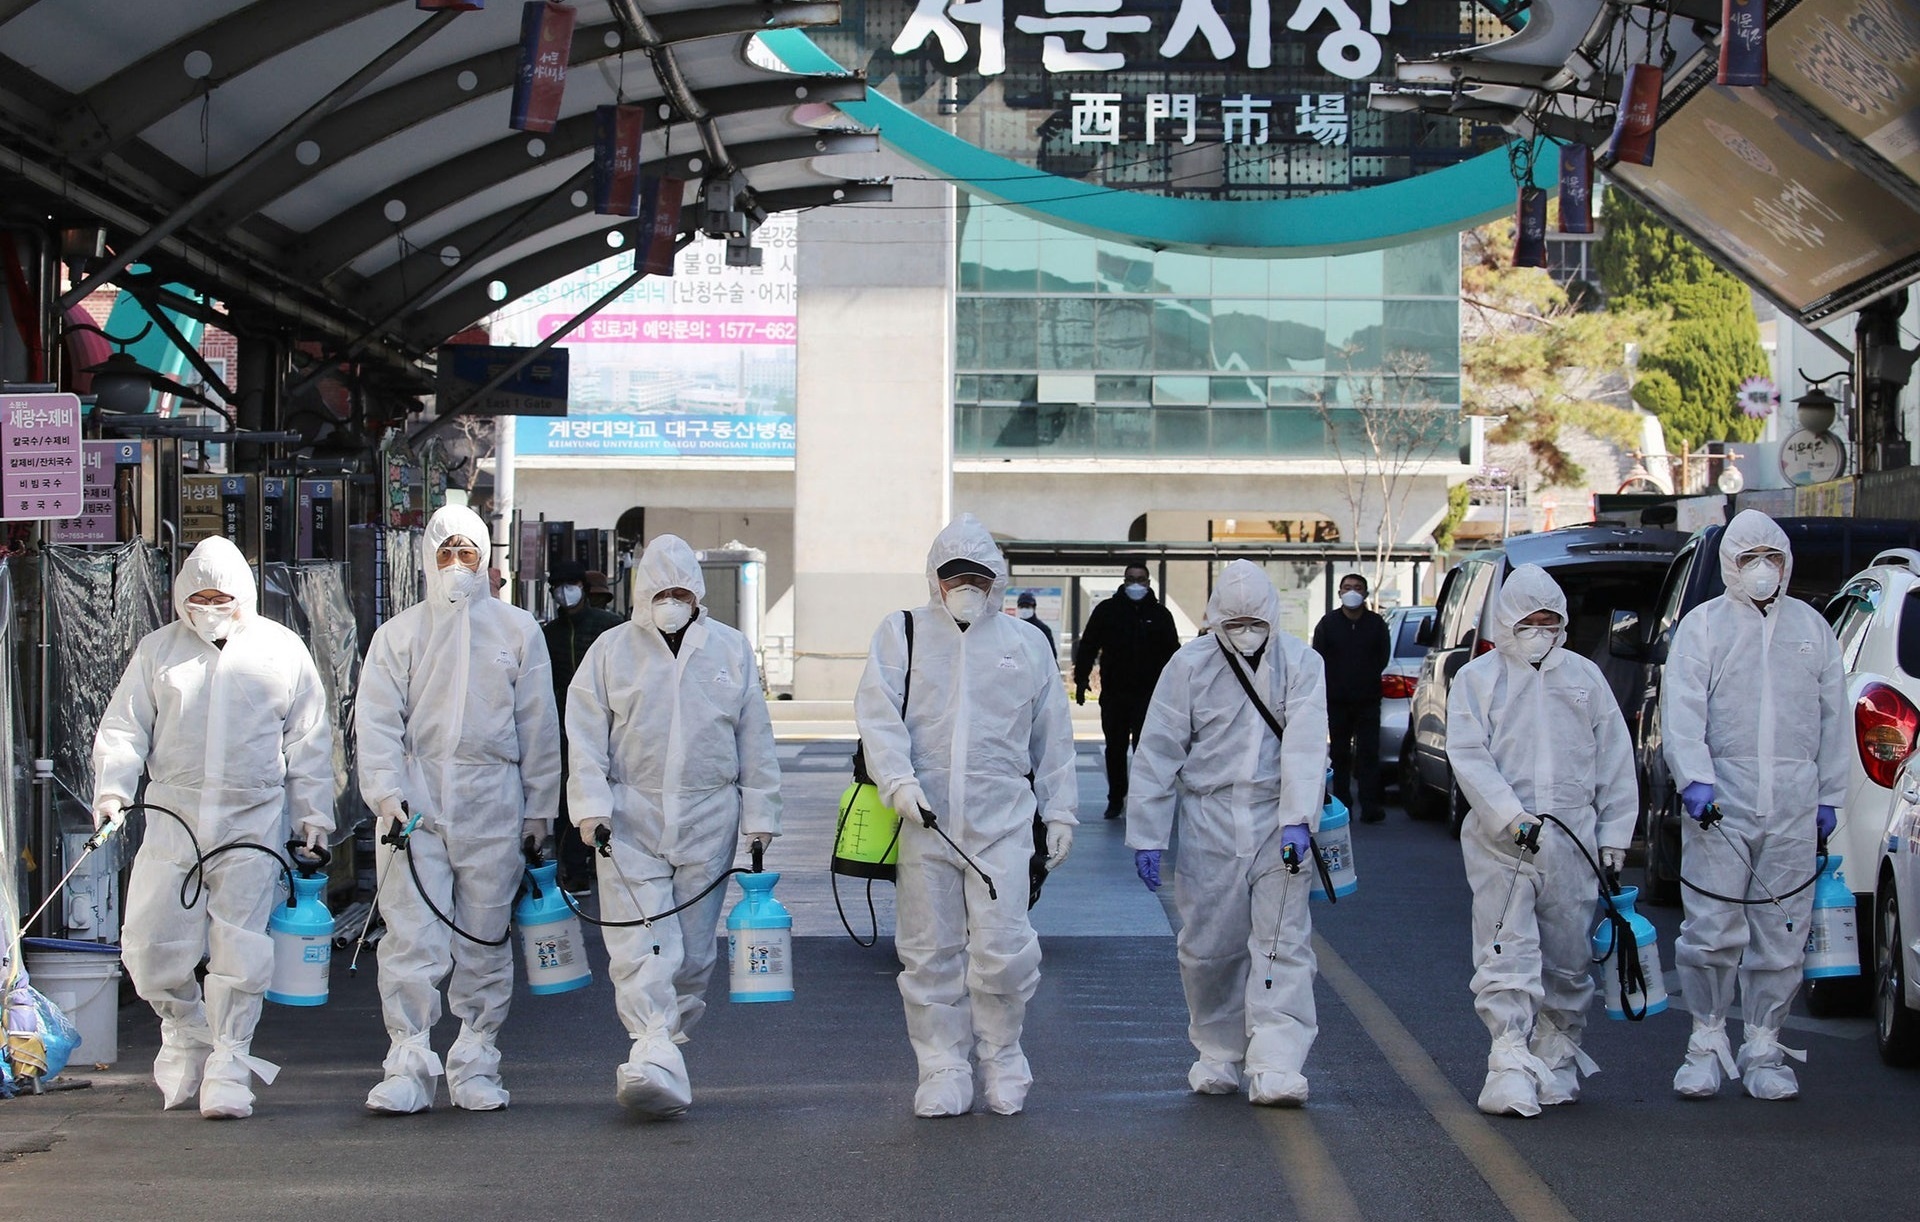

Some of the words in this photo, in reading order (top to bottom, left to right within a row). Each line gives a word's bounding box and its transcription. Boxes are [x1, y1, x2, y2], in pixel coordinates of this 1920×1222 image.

[891, 0, 1402, 79] 서문시장
[1070, 93, 1348, 146] 西門市場
[591, 320, 637, 339] 진료과
[643, 320, 711, 339] 예약문의:
[486, 398, 510, 409] East
[524, 398, 553, 409] Gate
[9, 408, 73, 429] 세광수제비
[548, 420, 659, 438] 계명대학교
[665, 420, 796, 439] 대구동산병원
[13, 436, 70, 446] 칼국수/수제비
[548, 440, 600, 449] KEIMYUNG
[602, 440, 661, 449] UNIVERSITY
[664, 440, 697, 449] DAEGU
[700, 440, 748, 449] DONGSAN
